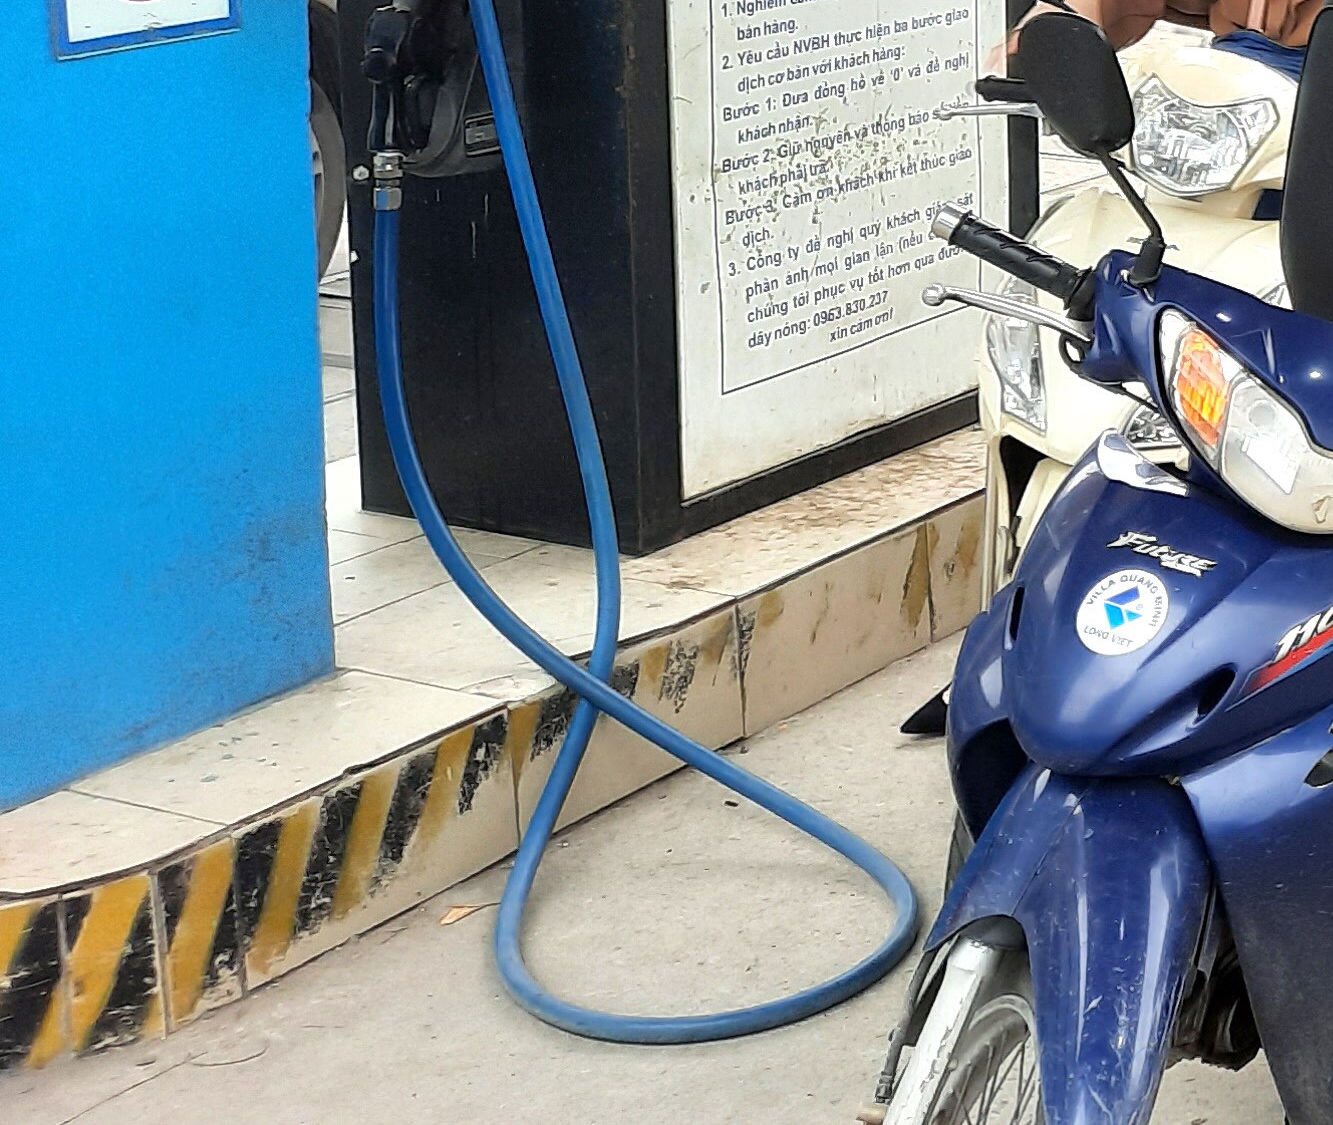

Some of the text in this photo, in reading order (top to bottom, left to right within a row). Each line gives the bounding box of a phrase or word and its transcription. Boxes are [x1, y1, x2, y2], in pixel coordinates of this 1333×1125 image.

[721, 3, 733, 17] 1.
[793, 34, 830, 55] NVBH
[723, 102, 760, 122] Bước
[738, 122, 776, 144] khách
[1086, 578, 1116, 606] VILLA
